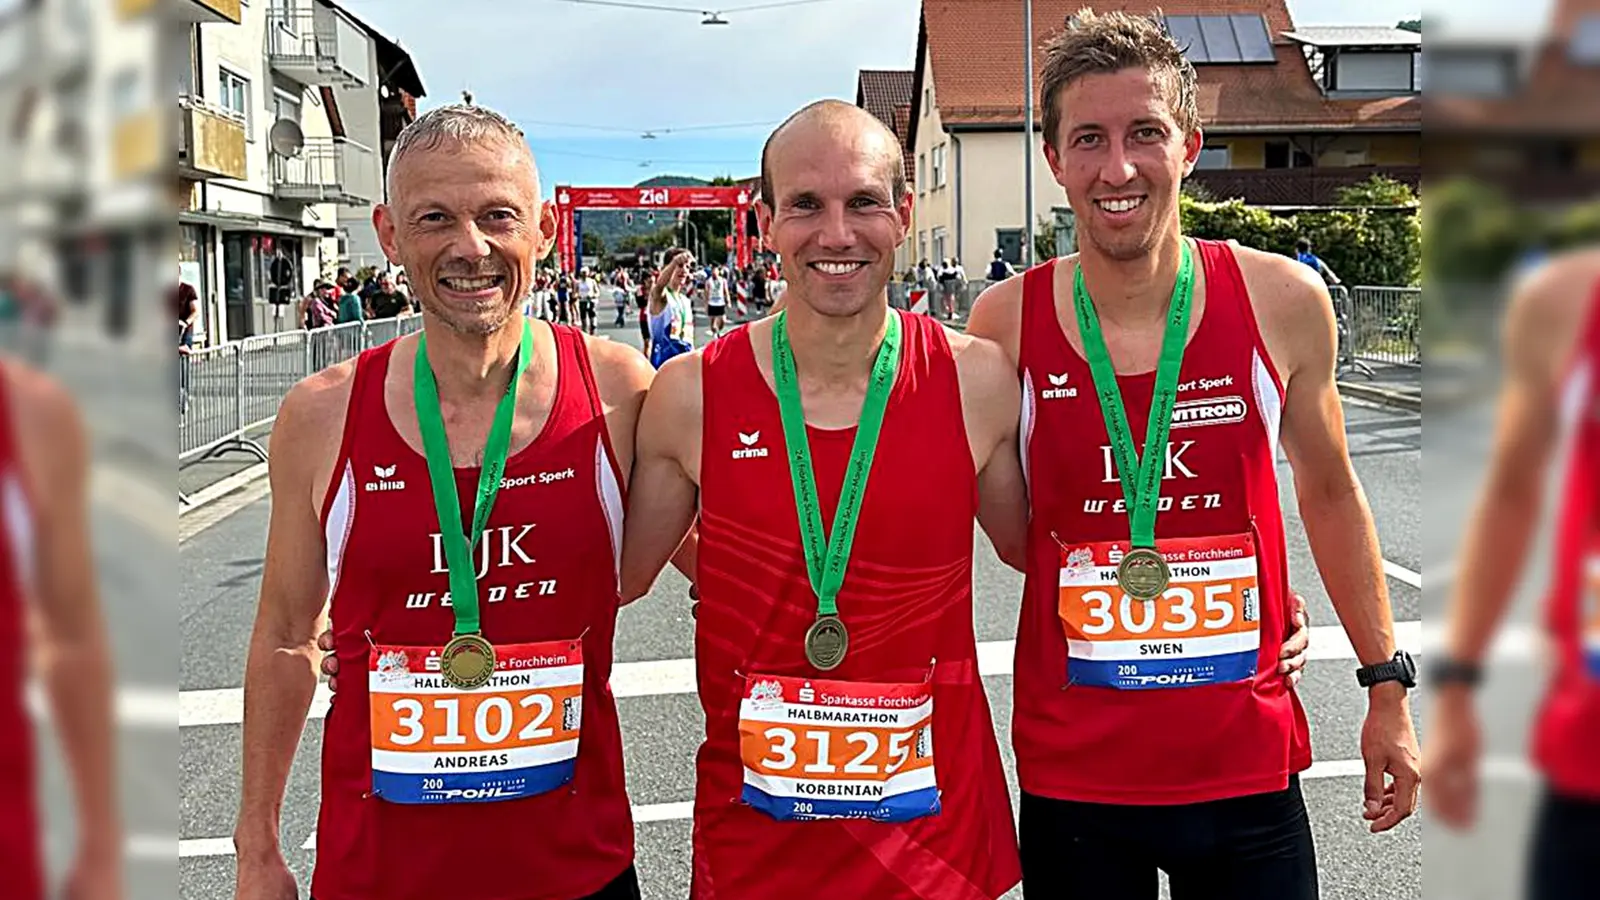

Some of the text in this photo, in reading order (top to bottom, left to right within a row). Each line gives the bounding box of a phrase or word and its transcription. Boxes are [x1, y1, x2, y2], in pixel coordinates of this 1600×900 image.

[639, 189, 669, 204] Ziel
[1177, 375, 1233, 392] ort Sperk
[732, 446, 768, 459] erima
[499, 468, 575, 489] Sport Sperk
[1084, 493, 1221, 513] WEDEN
[1188, 548, 1243, 562] Forchheim
[406, 579, 556, 608] WEDEN
[1081, 584, 1234, 634] 3035
[1140, 643, 1183, 655] SWEN
[509, 654, 567, 669] Forchheim
[1118, 665, 1137, 675] 200
[820, 693, 876, 708] Sparkasse
[389, 693, 554, 745] 3102
[788, 709, 898, 723] HALBMARATHON
[761, 727, 914, 774] 3125
[434, 754, 508, 769] ANDREAS
[423, 778, 443, 789] 200
[796, 783, 883, 796] KORBINIAN
[793, 801, 813, 813] 200
